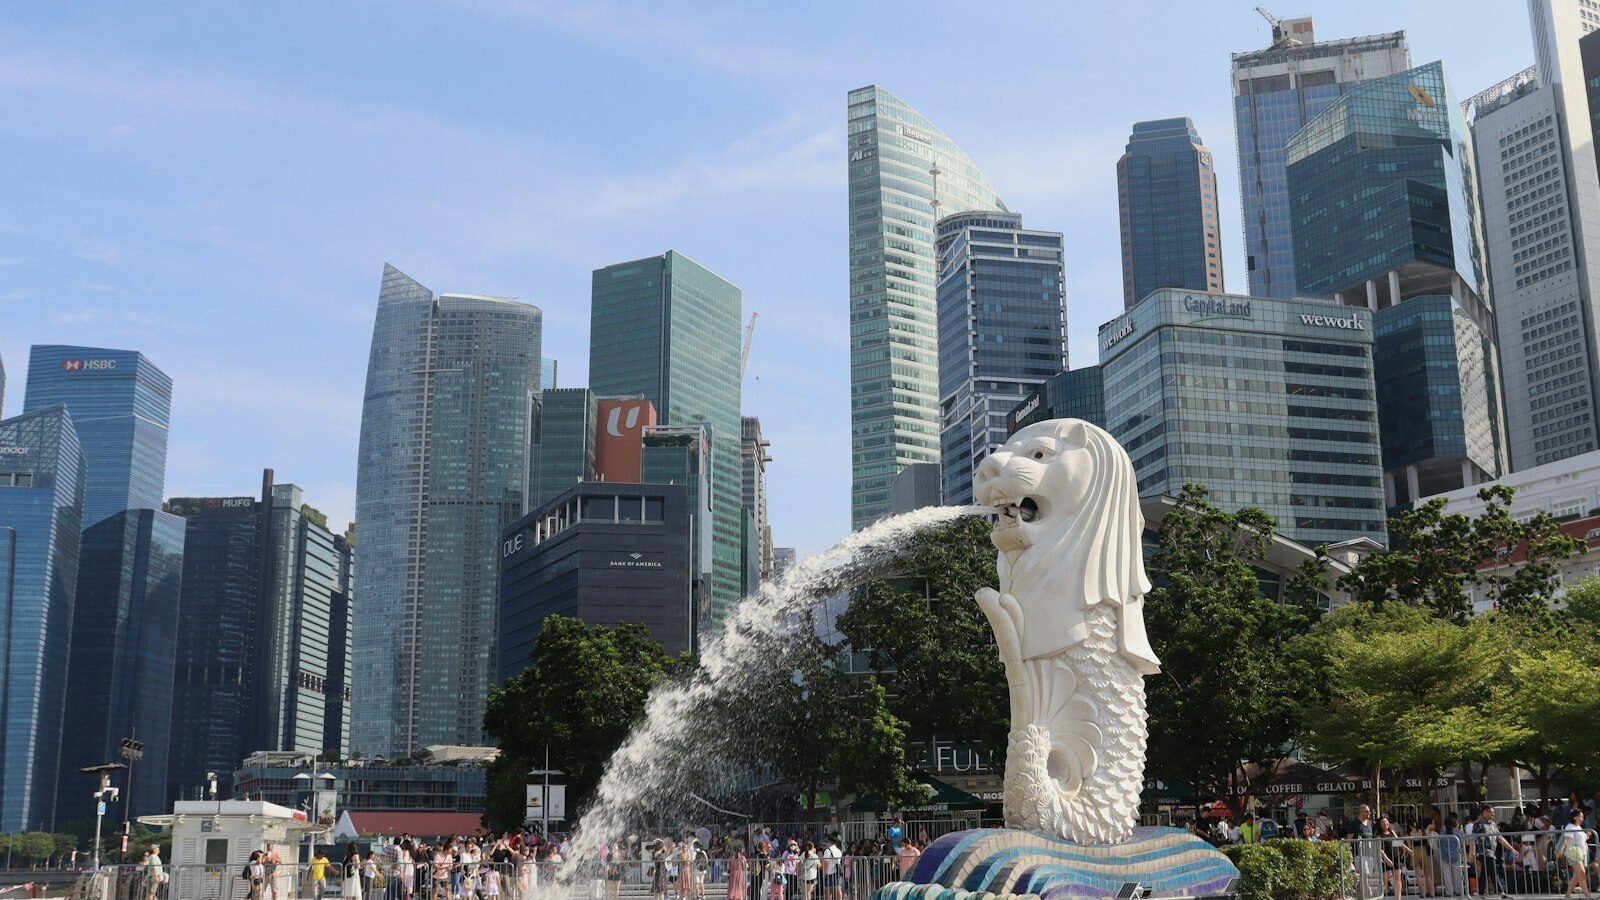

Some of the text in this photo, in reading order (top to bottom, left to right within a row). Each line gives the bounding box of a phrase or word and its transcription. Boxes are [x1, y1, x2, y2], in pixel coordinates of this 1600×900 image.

[1184, 294, 1251, 318] CapitaLand
[1300, 313, 1364, 330] wework
[1102, 316, 1133, 350] wework
[83, 359, 116, 370] HSBC
[222, 499, 251, 507] MUFG
[503, 534, 523, 558] OUE
[1265, 783, 1303, 794] COFFEE
[1317, 782, 1356, 792] GELATO
[918, 804, 949, 812] BURGER
